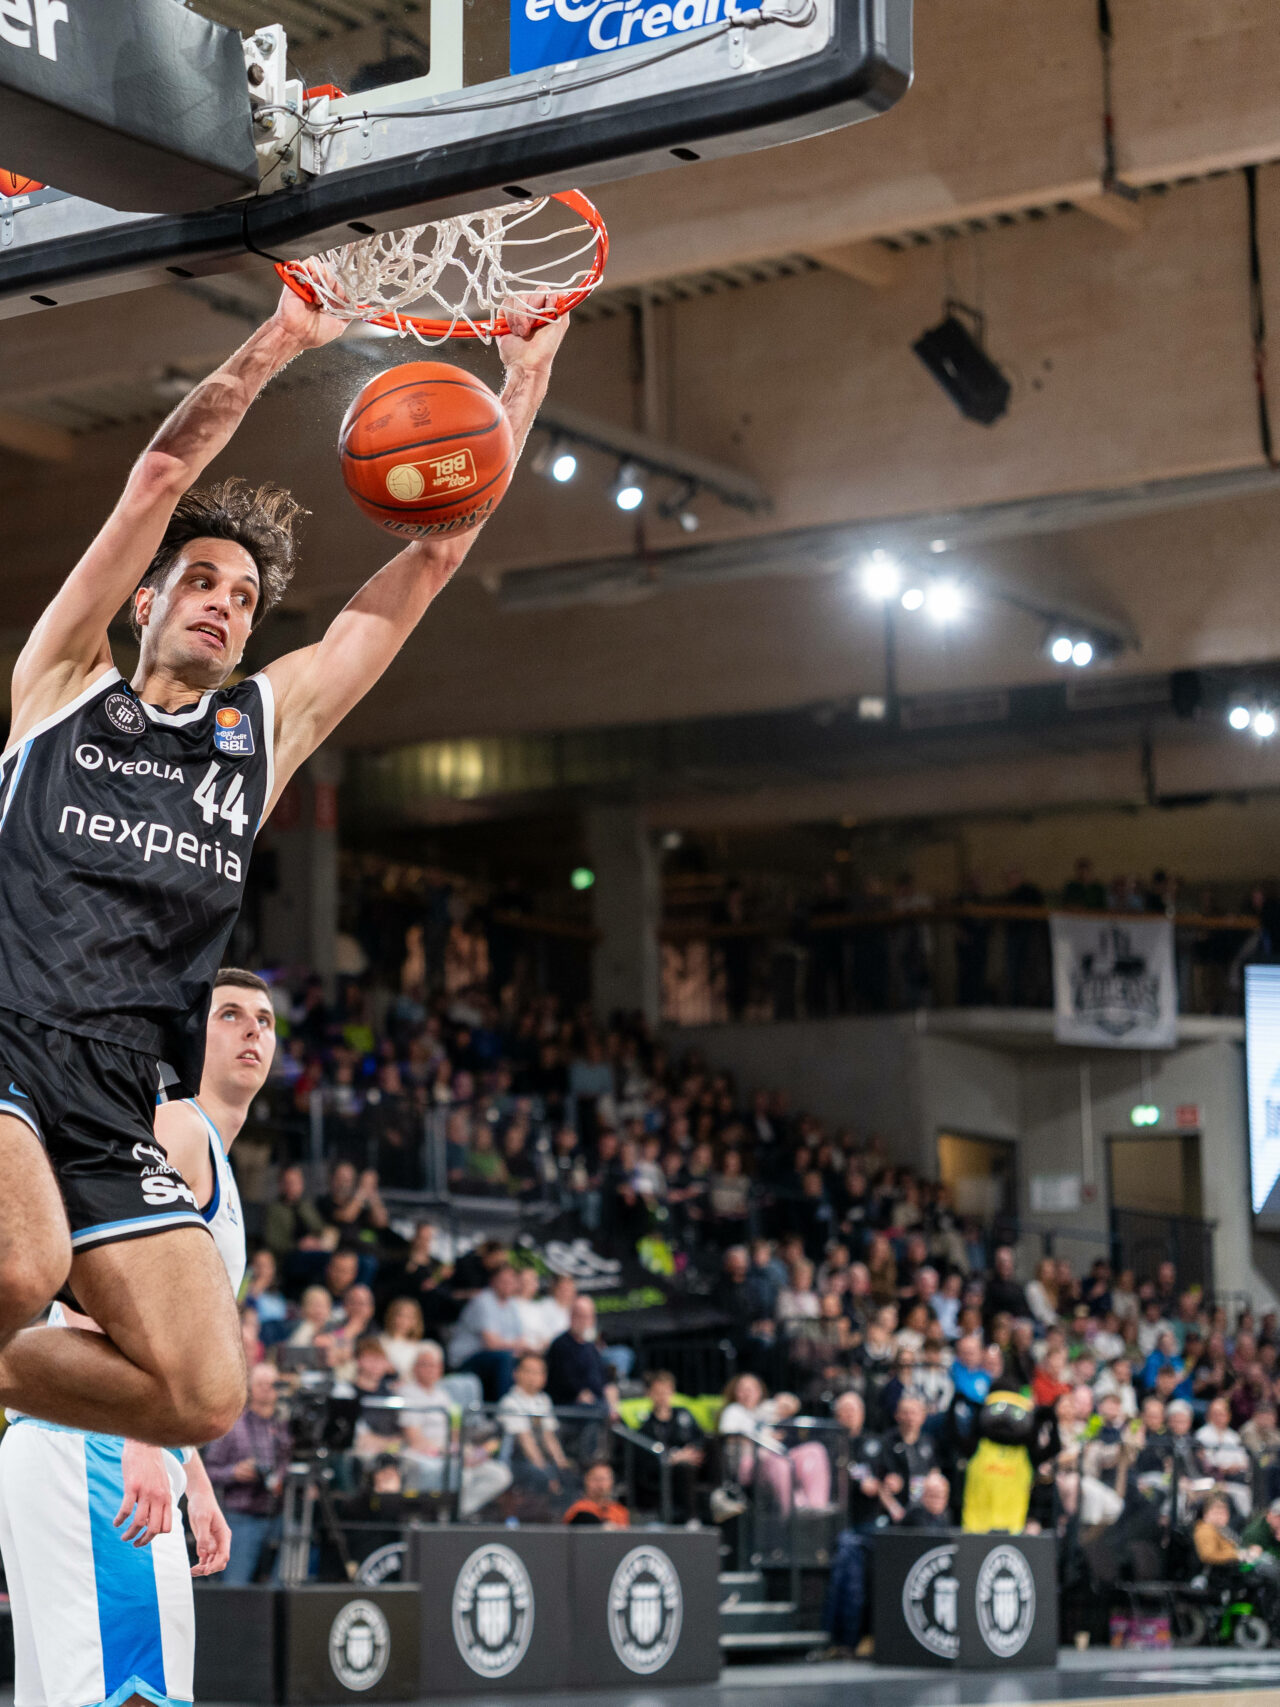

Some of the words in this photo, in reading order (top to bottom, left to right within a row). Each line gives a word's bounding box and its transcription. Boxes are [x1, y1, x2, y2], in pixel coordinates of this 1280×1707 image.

[429, 453, 466, 477] BBL
[220, 740, 249, 751] BBL
[107, 757, 185, 784] VEOLIA
[193, 760, 249, 837] 44
[58, 805, 242, 883] nexperia
